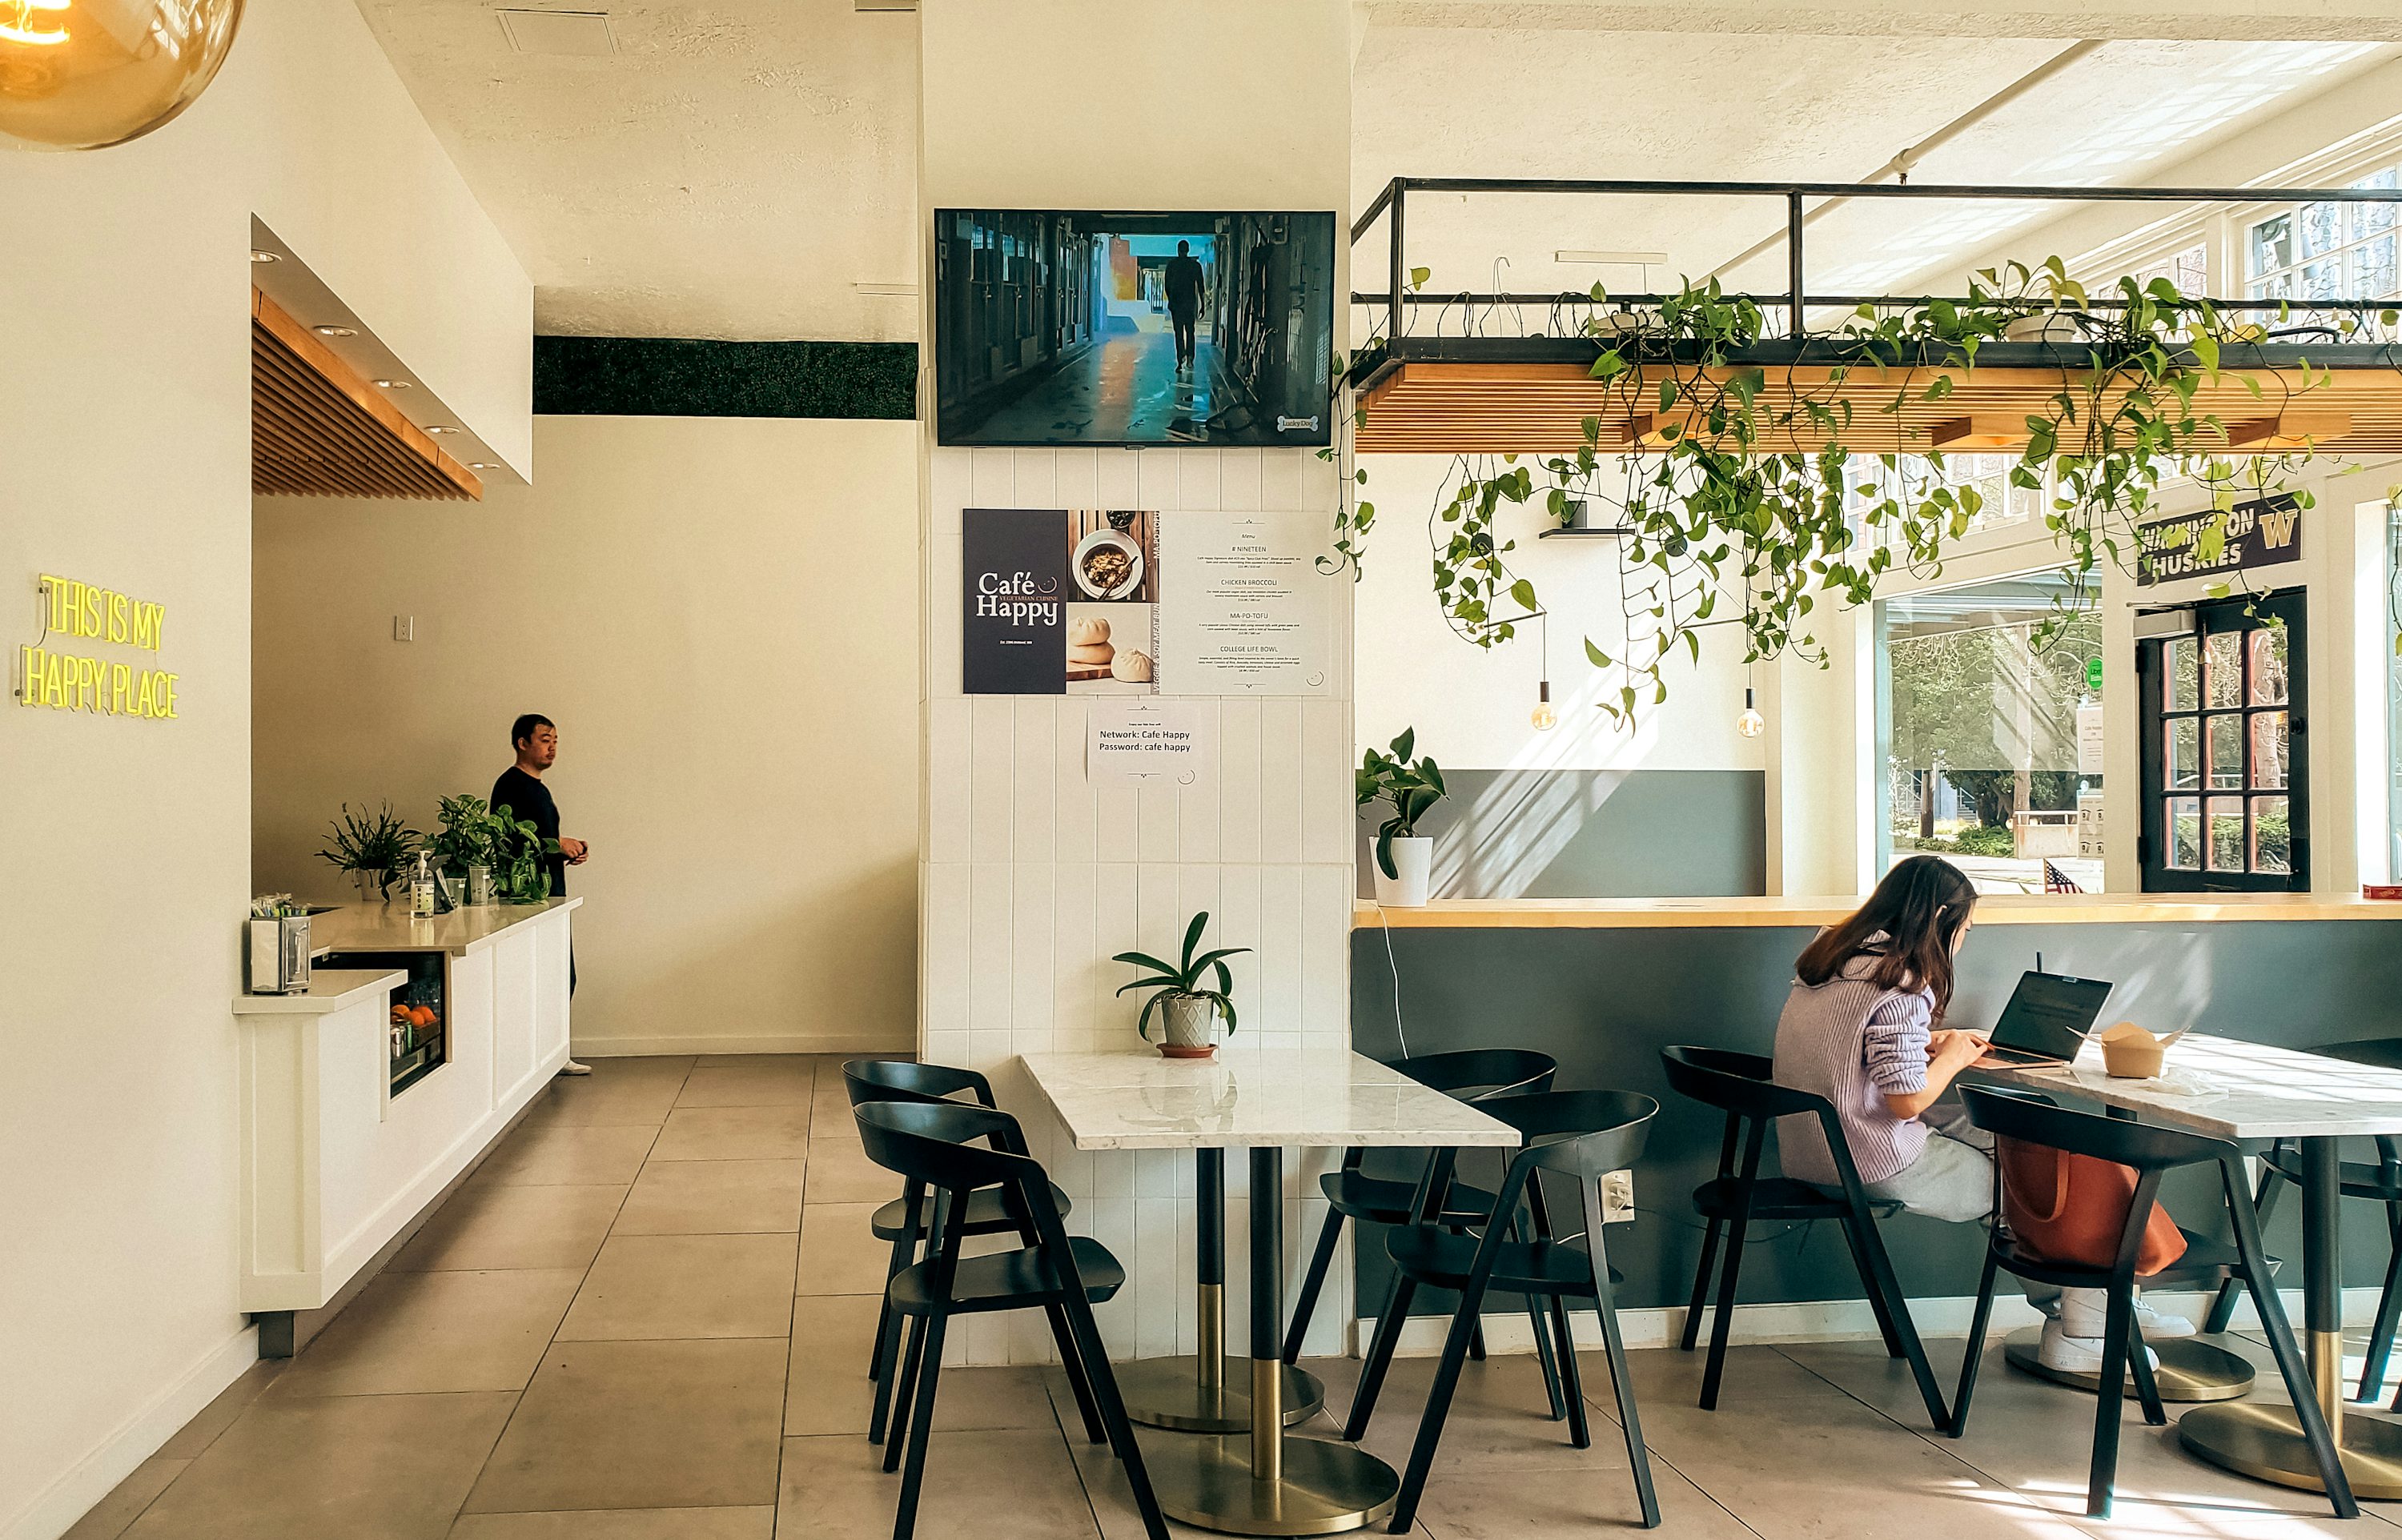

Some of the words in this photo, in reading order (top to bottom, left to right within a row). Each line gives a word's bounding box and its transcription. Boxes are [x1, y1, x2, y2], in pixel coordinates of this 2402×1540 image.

[2258, 508, 2298, 550] W
[978, 571, 1035, 595] Café
[41, 575, 101, 638] THIS
[102, 590, 129, 644] IS
[129, 600, 165, 652] MY
[976, 595, 1058, 626] Happy
[22, 647, 106, 711] HAPPY
[110, 664, 179, 719] PLACE
[1099, 743, 1143, 751] Password:
[1144, 743, 1162, 751] cafe
[1164, 743, 1191, 752] happy
[1163, 731, 1190, 740] Happy
